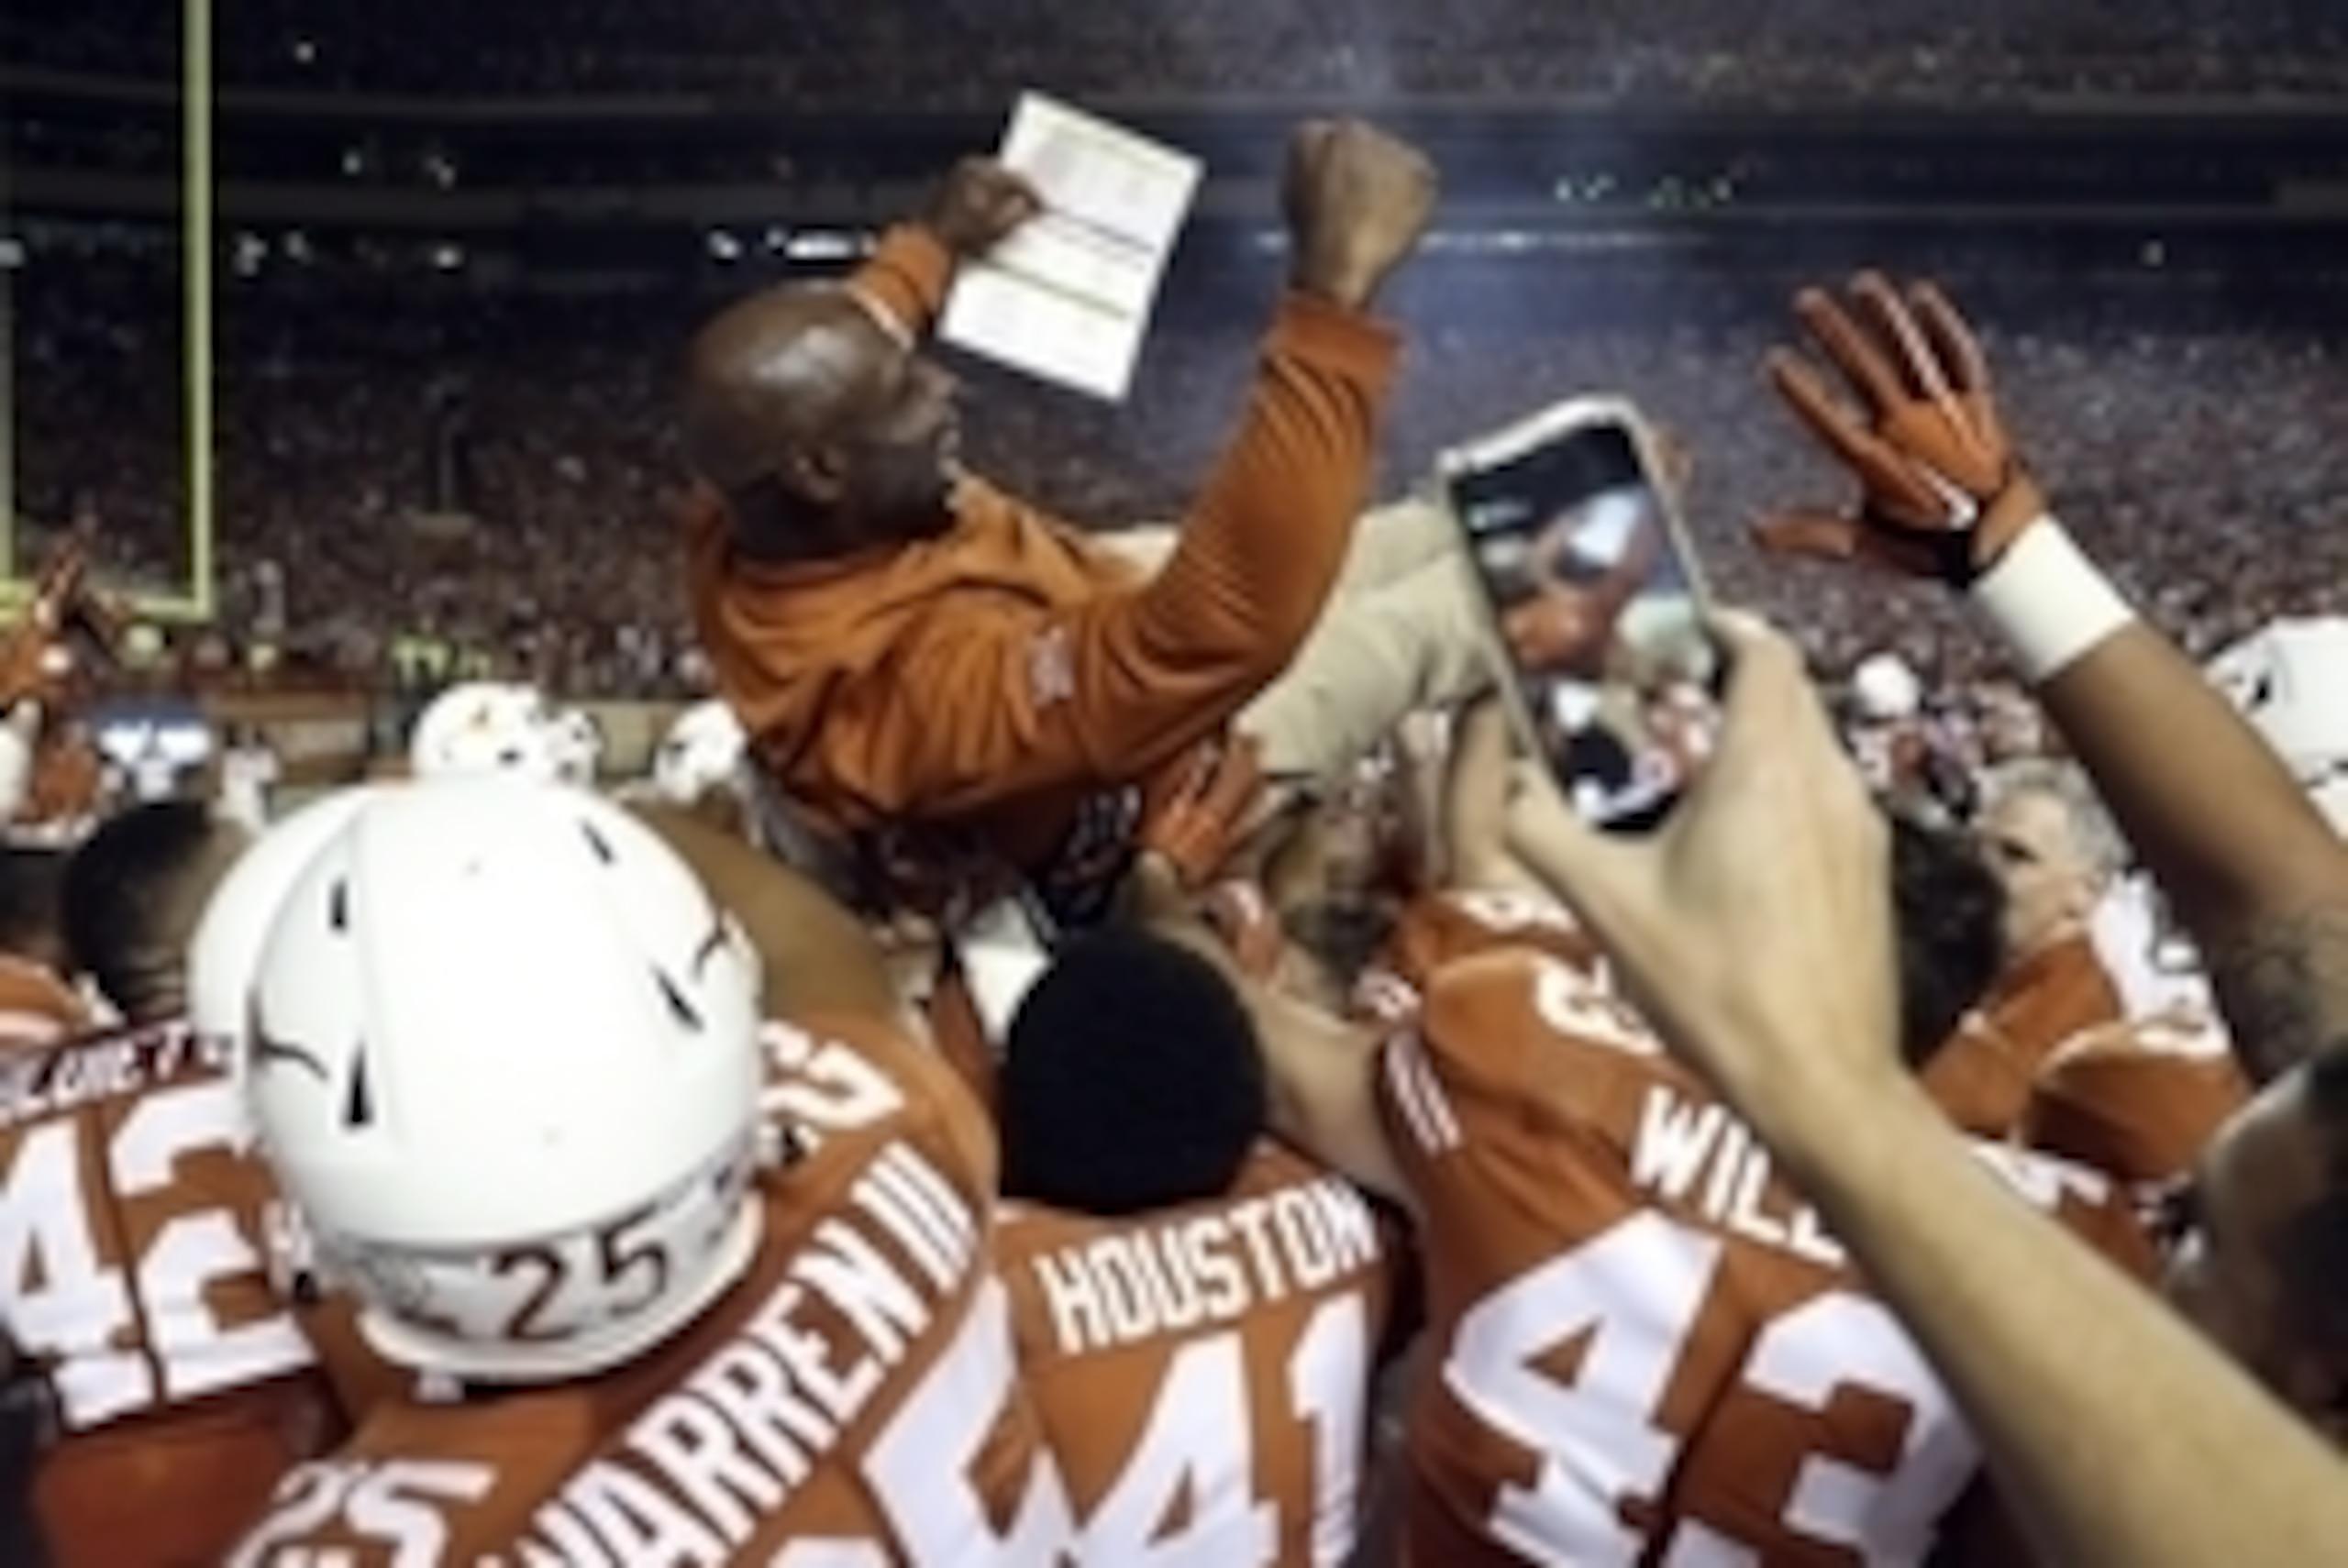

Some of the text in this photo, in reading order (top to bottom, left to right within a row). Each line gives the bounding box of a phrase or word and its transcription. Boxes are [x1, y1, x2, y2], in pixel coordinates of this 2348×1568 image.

[0, 1080, 317, 1430] 42
[490, 1203, 670, 1342] 25
[848, 1139, 983, 1295] III
[1031, 1174, 1378, 1357] HOUSTON
[1069, 1286, 1367, 1568] 41
[1442, 1207, 1985, 1568] 43
